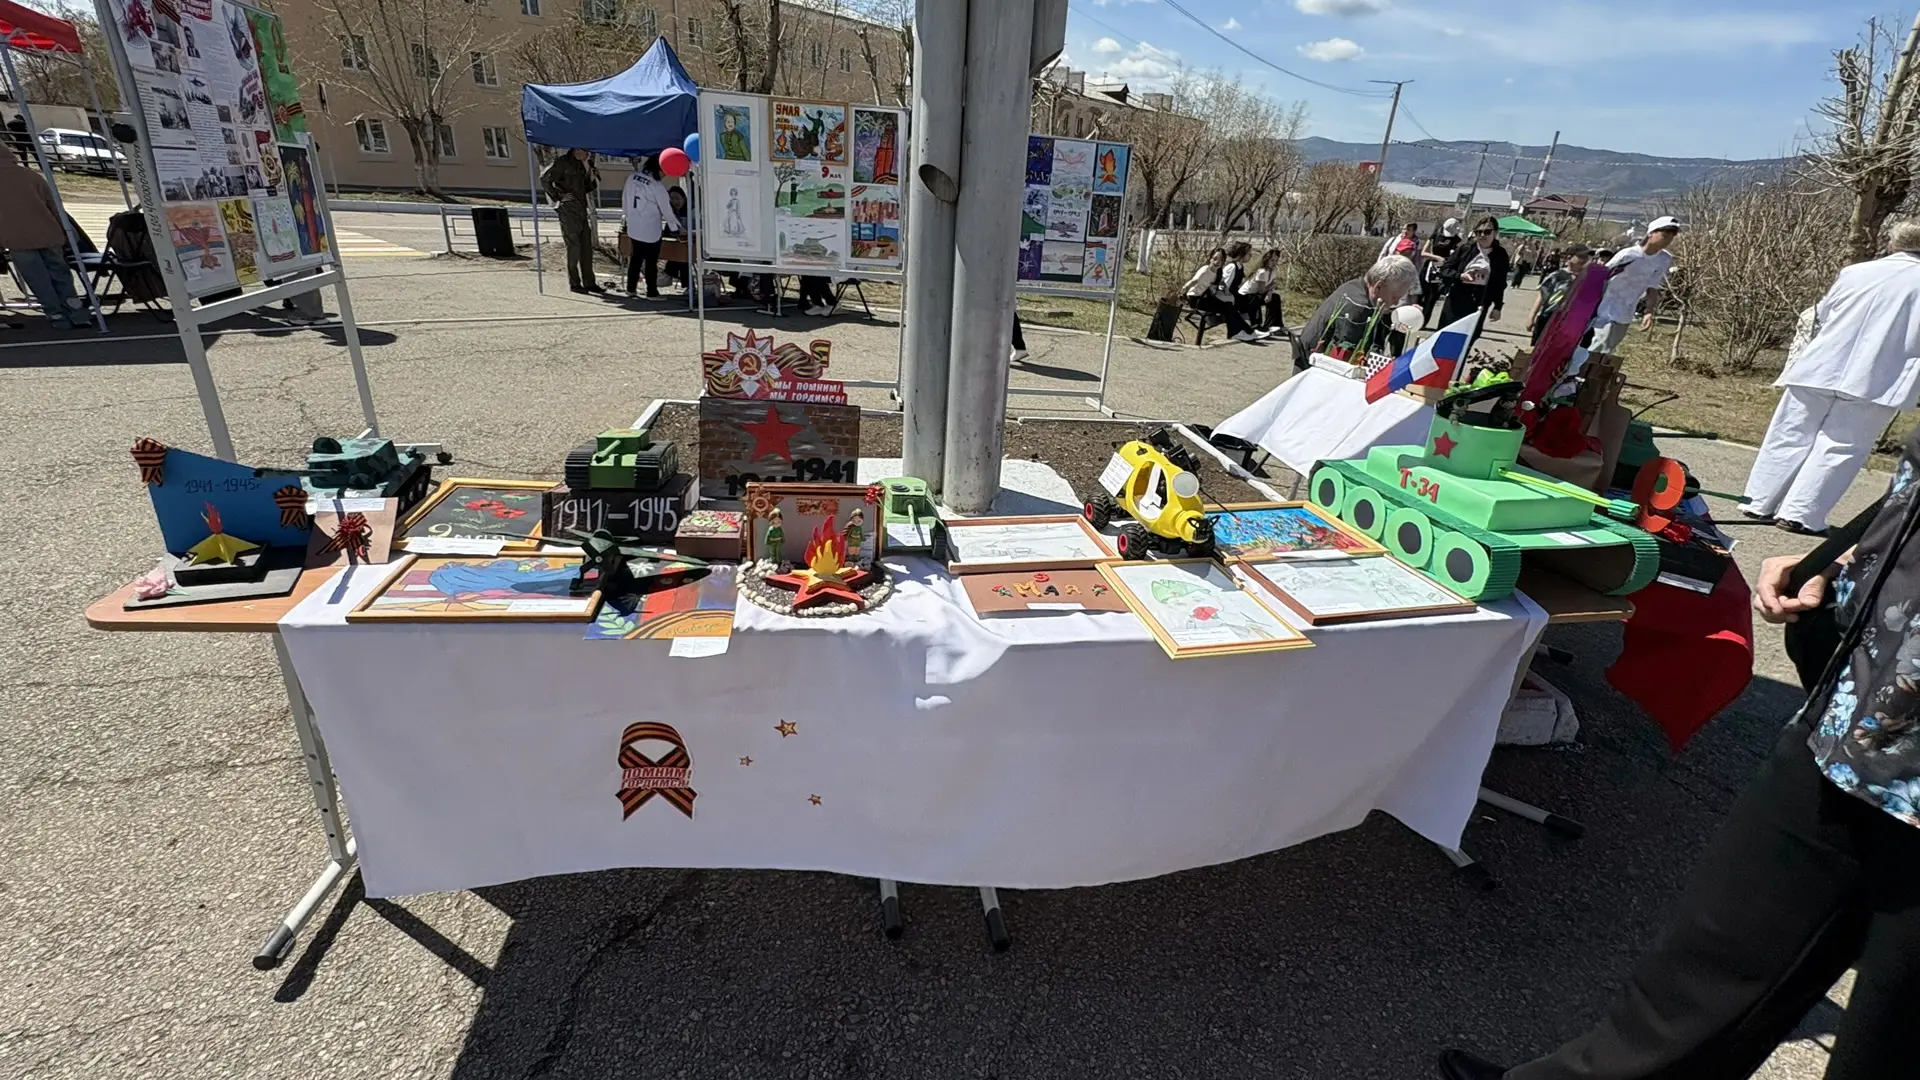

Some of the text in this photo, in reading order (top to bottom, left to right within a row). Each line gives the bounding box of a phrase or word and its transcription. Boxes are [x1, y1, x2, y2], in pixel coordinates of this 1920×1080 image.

[821, 166, 830, 178] 9
[775, 381, 841, 393] МЫ ПОМНИМ!
[769, 391, 845, 404] МЫ ГОРДИМСЯ!
[792, 458, 856, 483] 1941
[1400, 467, 1440, 504] Т-34
[622, 767, 692, 780] ПОМНИМ!
[621, 778, 690, 789] ГОРДИМСЯ!
